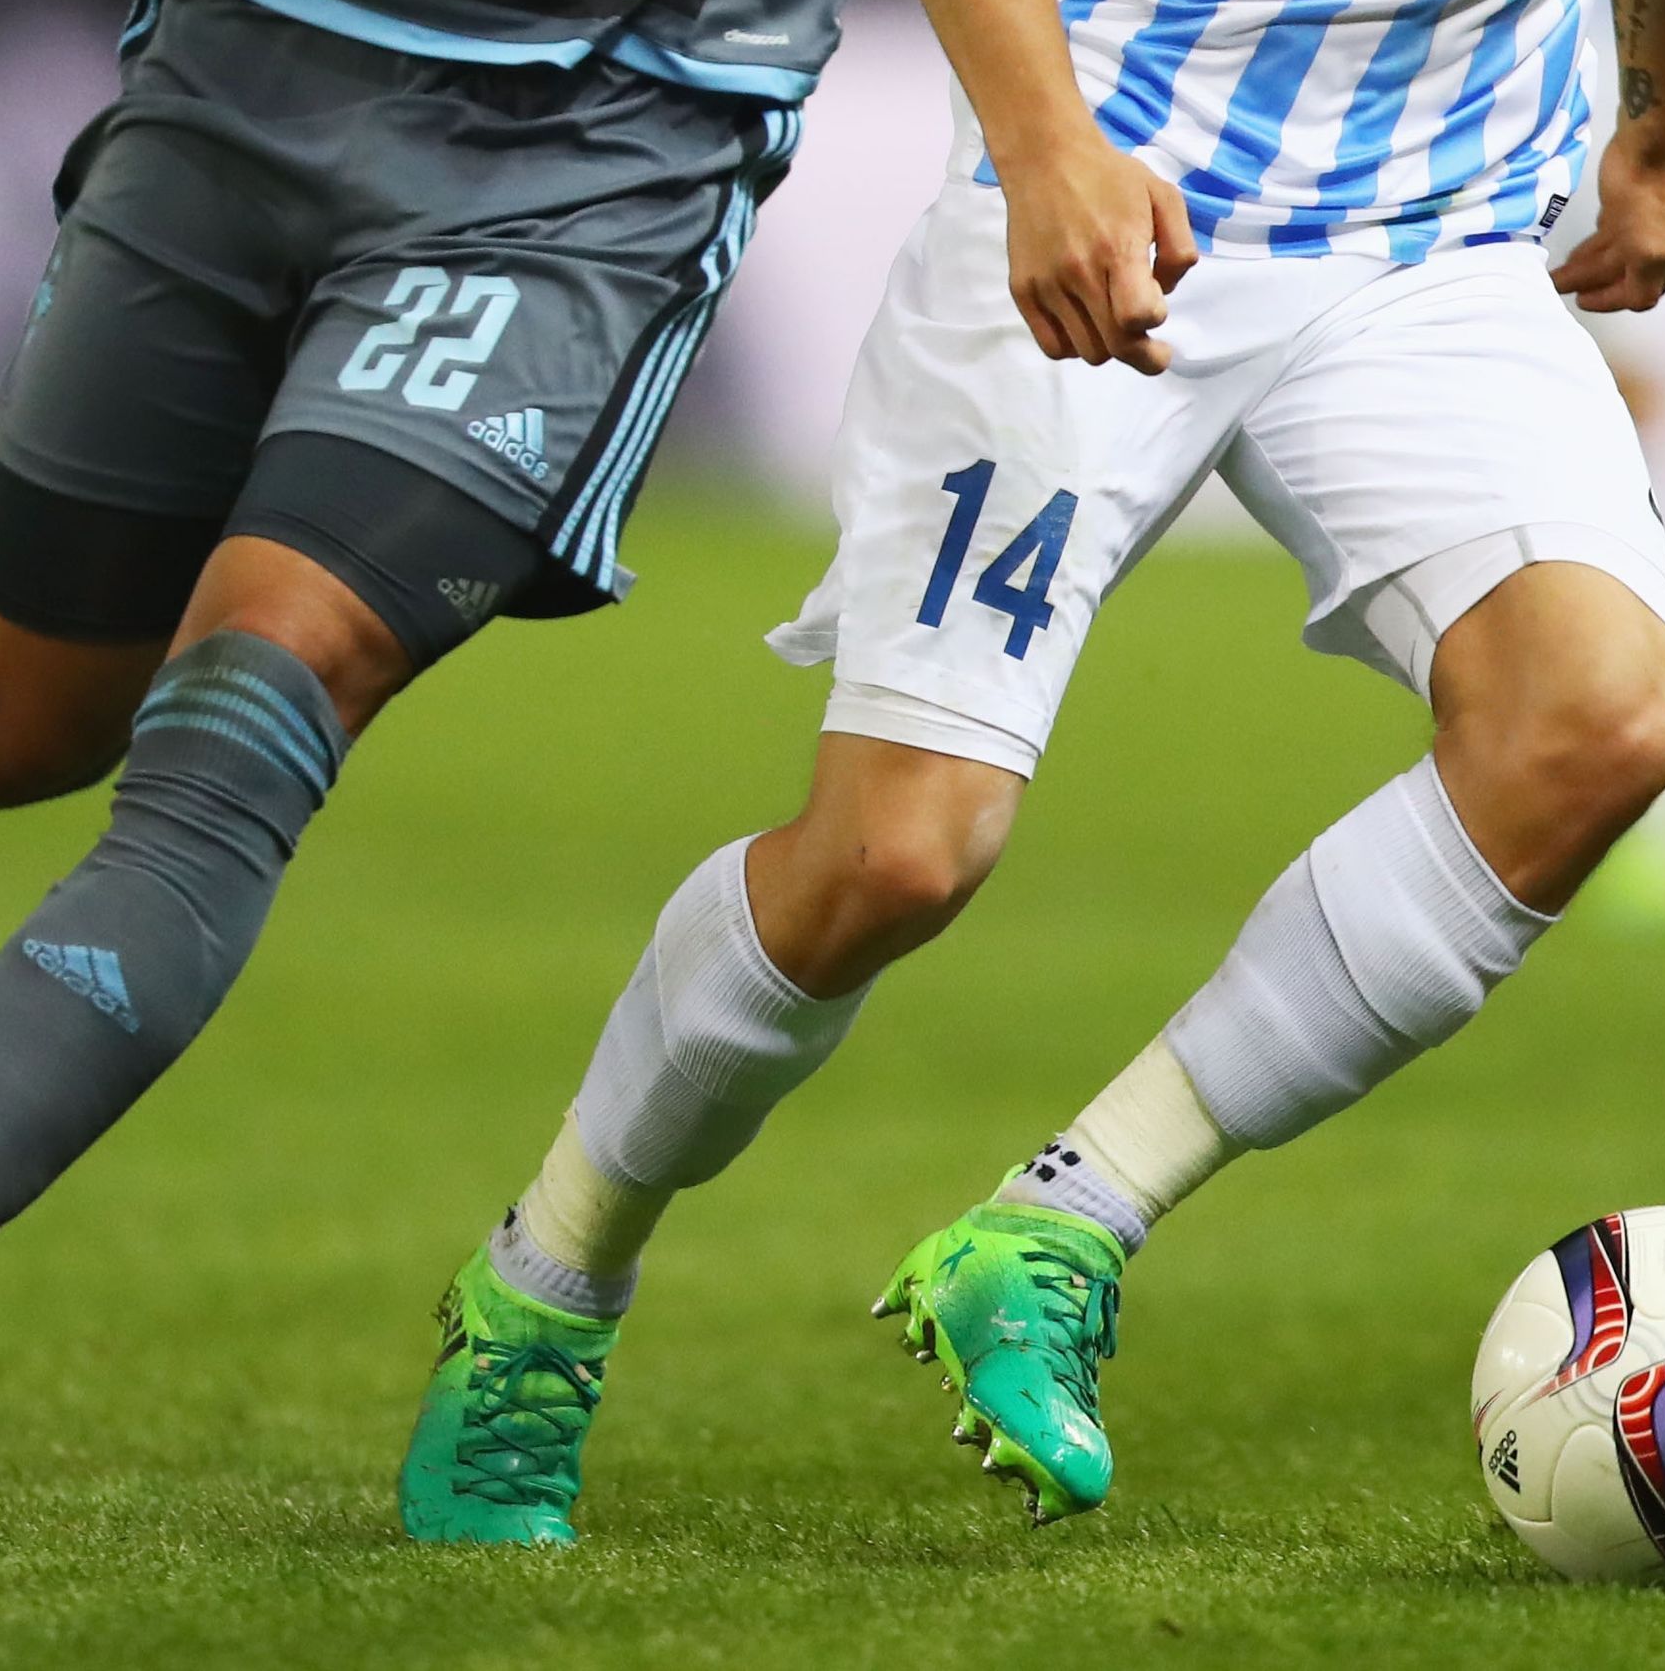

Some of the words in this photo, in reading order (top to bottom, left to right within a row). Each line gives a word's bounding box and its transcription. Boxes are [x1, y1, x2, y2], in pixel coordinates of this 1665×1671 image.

[337, 265, 521, 412] 22
[467, 420, 549, 480] adidas
[916, 458, 1079, 661] 14
[1488, 1429, 1517, 1475] adidas
